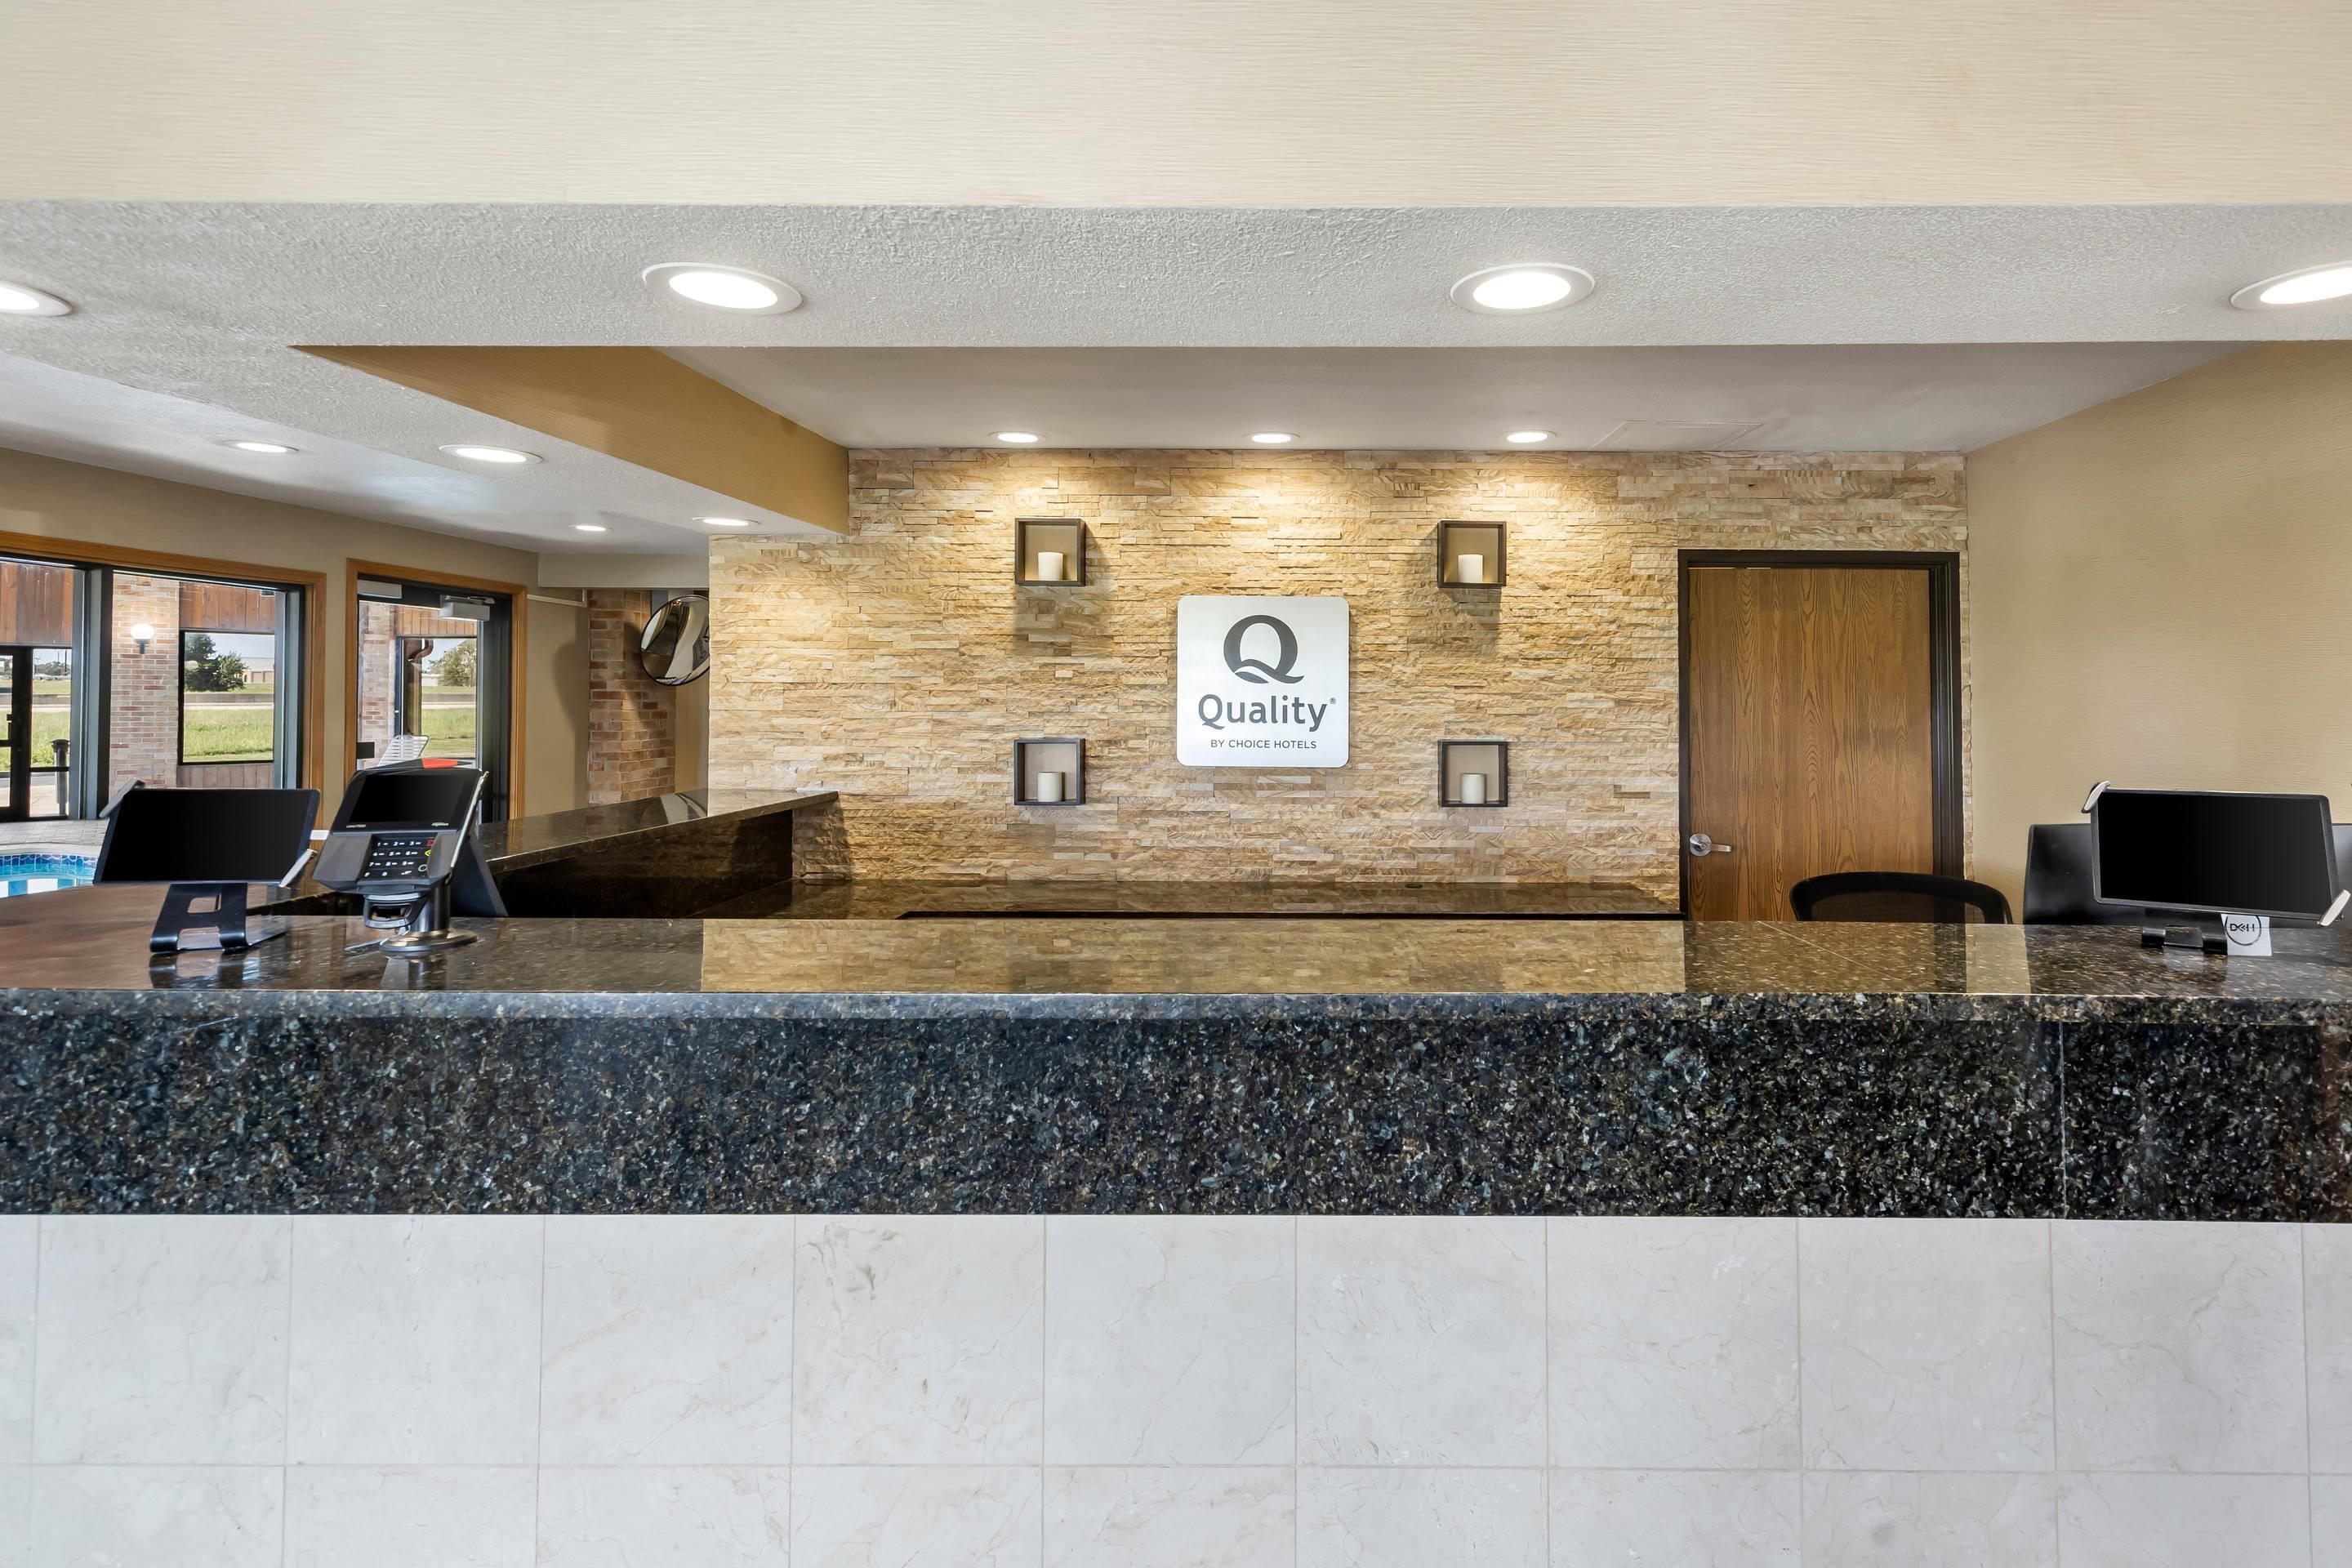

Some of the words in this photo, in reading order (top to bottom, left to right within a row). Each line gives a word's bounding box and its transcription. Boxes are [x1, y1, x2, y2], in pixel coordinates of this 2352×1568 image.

[1223, 614, 1305, 684] Q
[1210, 739, 1225, 748] BY
[1228, 739, 1271, 749] CHOICE
[1274, 740, 1317, 750] HOTELS
